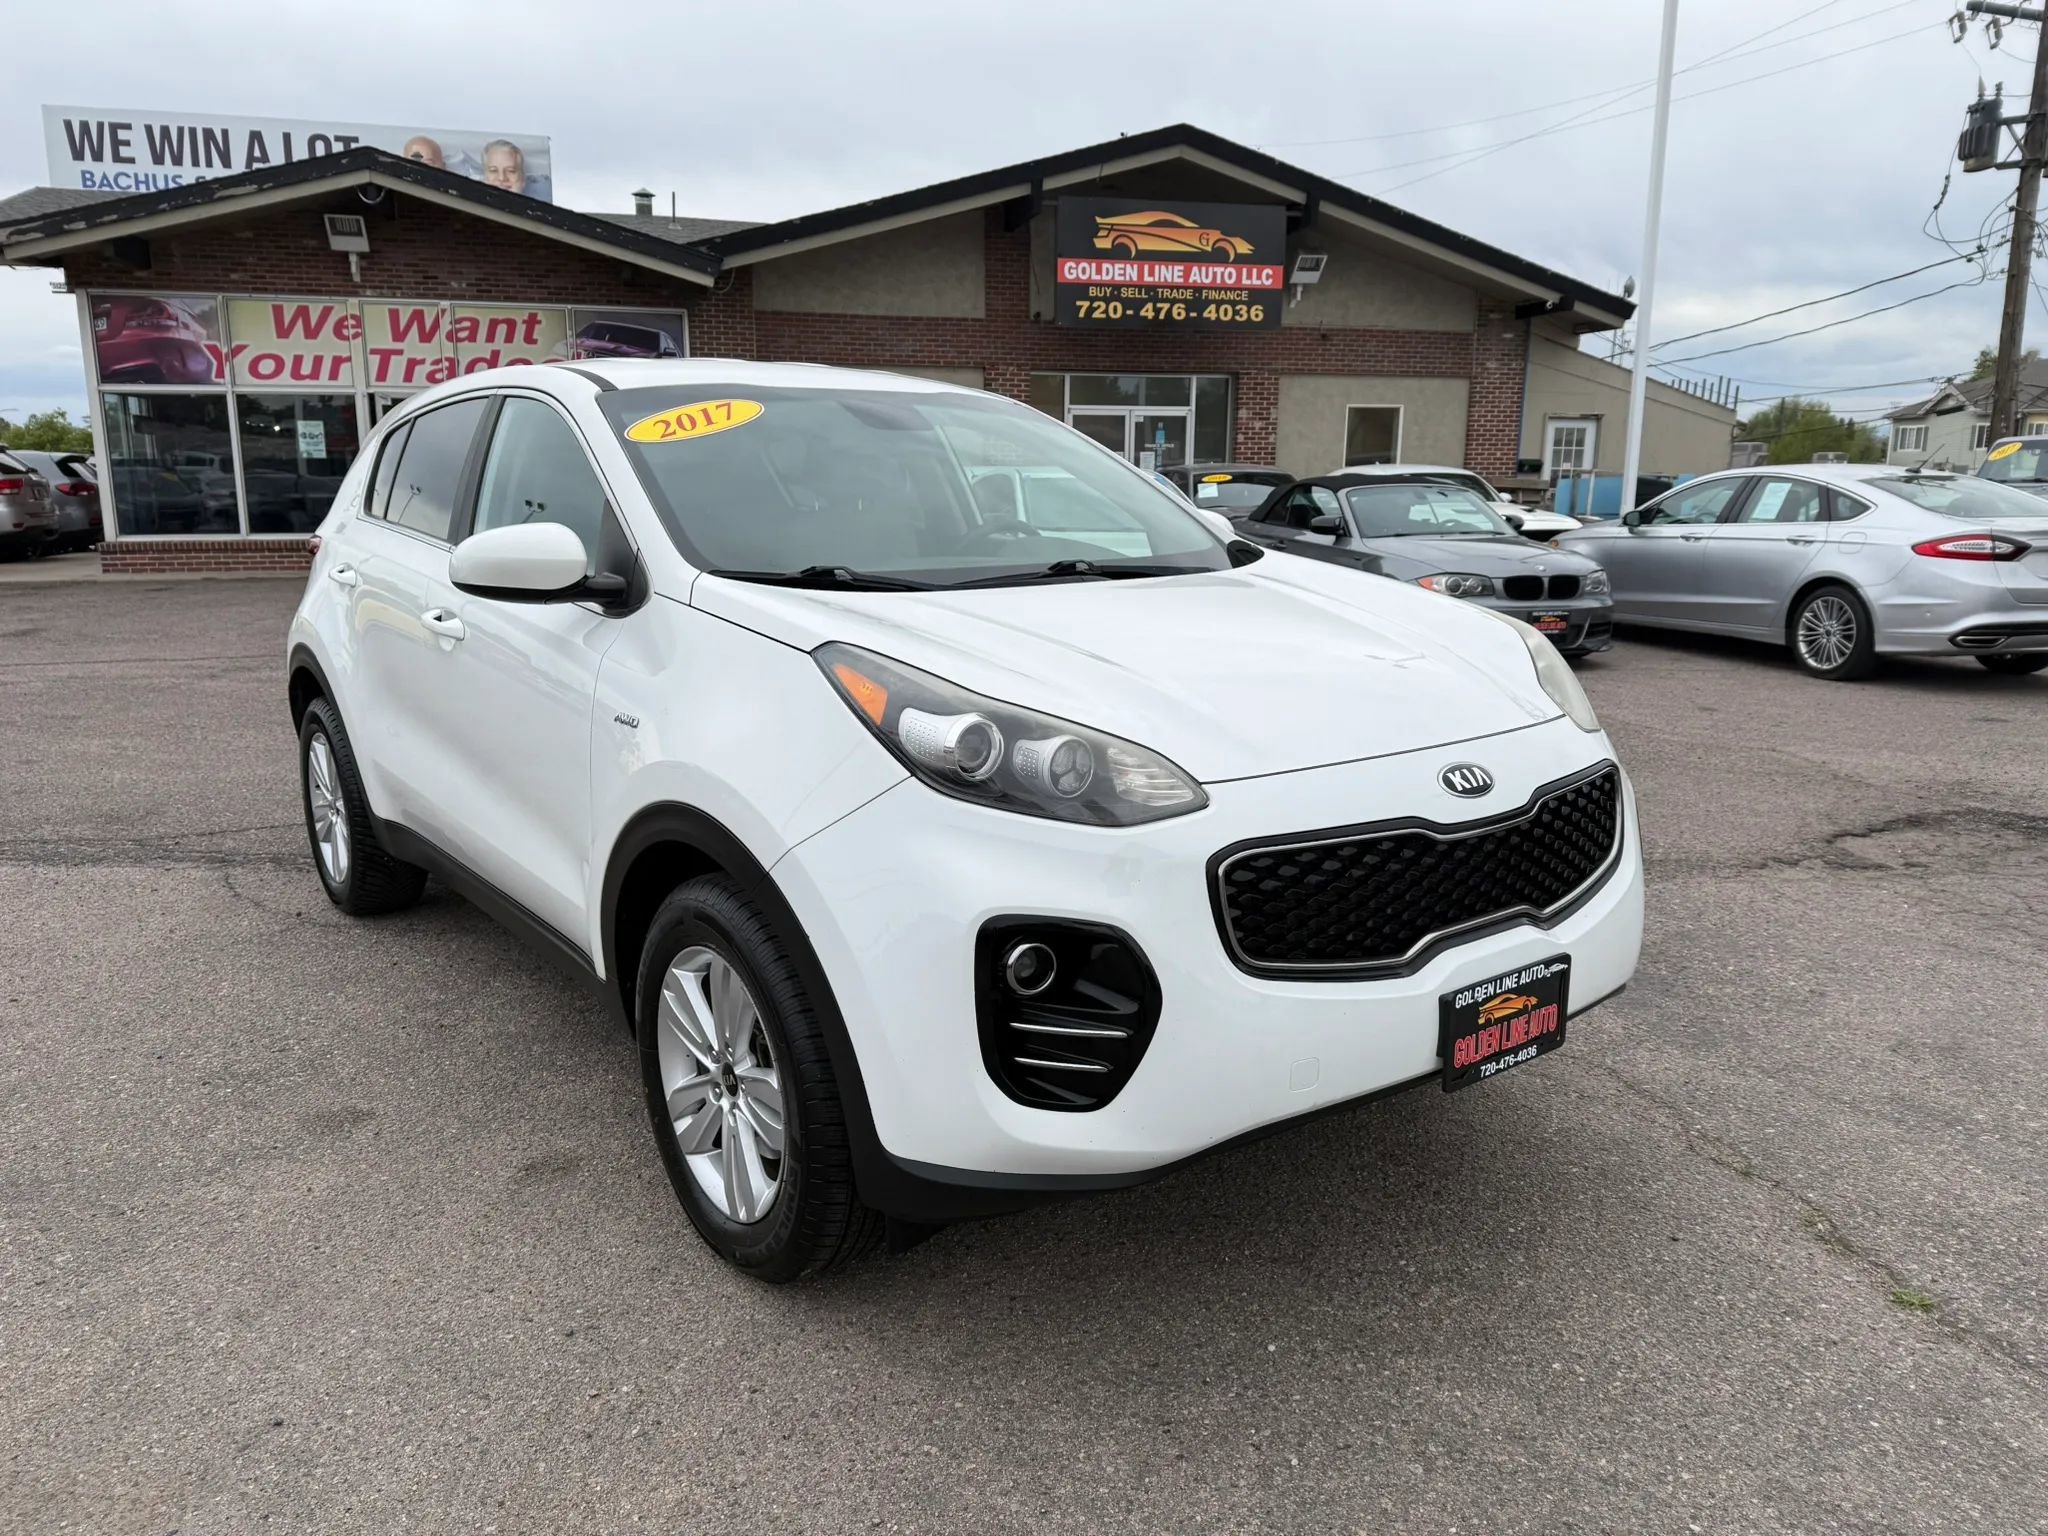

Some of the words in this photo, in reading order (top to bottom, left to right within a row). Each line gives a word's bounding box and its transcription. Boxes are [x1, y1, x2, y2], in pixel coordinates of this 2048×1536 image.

[63, 119, 136, 164] WE
[144, 123, 232, 169] WIN
[245, 130, 270, 170] A
[81, 169, 183, 191] BACHUS
[1064, 261, 1138, 282] GOLDEN
[1144, 264, 1184, 283] LINE
[1189, 266, 1237, 284] AUTO
[1241, 268, 1273, 286] LLC
[1089, 286, 1112, 297] BUY
[1120, 288, 1148, 298] SELL
[1156, 288, 1194, 300] TRADE
[1202, 290, 1249, 301] FINANCE
[271, 303, 363, 342] We
[387, 308, 543, 346] Want
[204, 343, 351, 382] Your
[653, 401, 732, 439] 2017
[1445, 767, 1491, 791] KIA
[1496, 973, 1518, 993] LINE
[1519, 964, 1545, 986] AUTO
[1453, 1023, 1502, 1069] GOLDEN
[1501, 1014, 1529, 1050] LINE
[1528, 1003, 1558, 1040] AUTO
[1480, 1045, 1537, 1078] 720-476-4036
